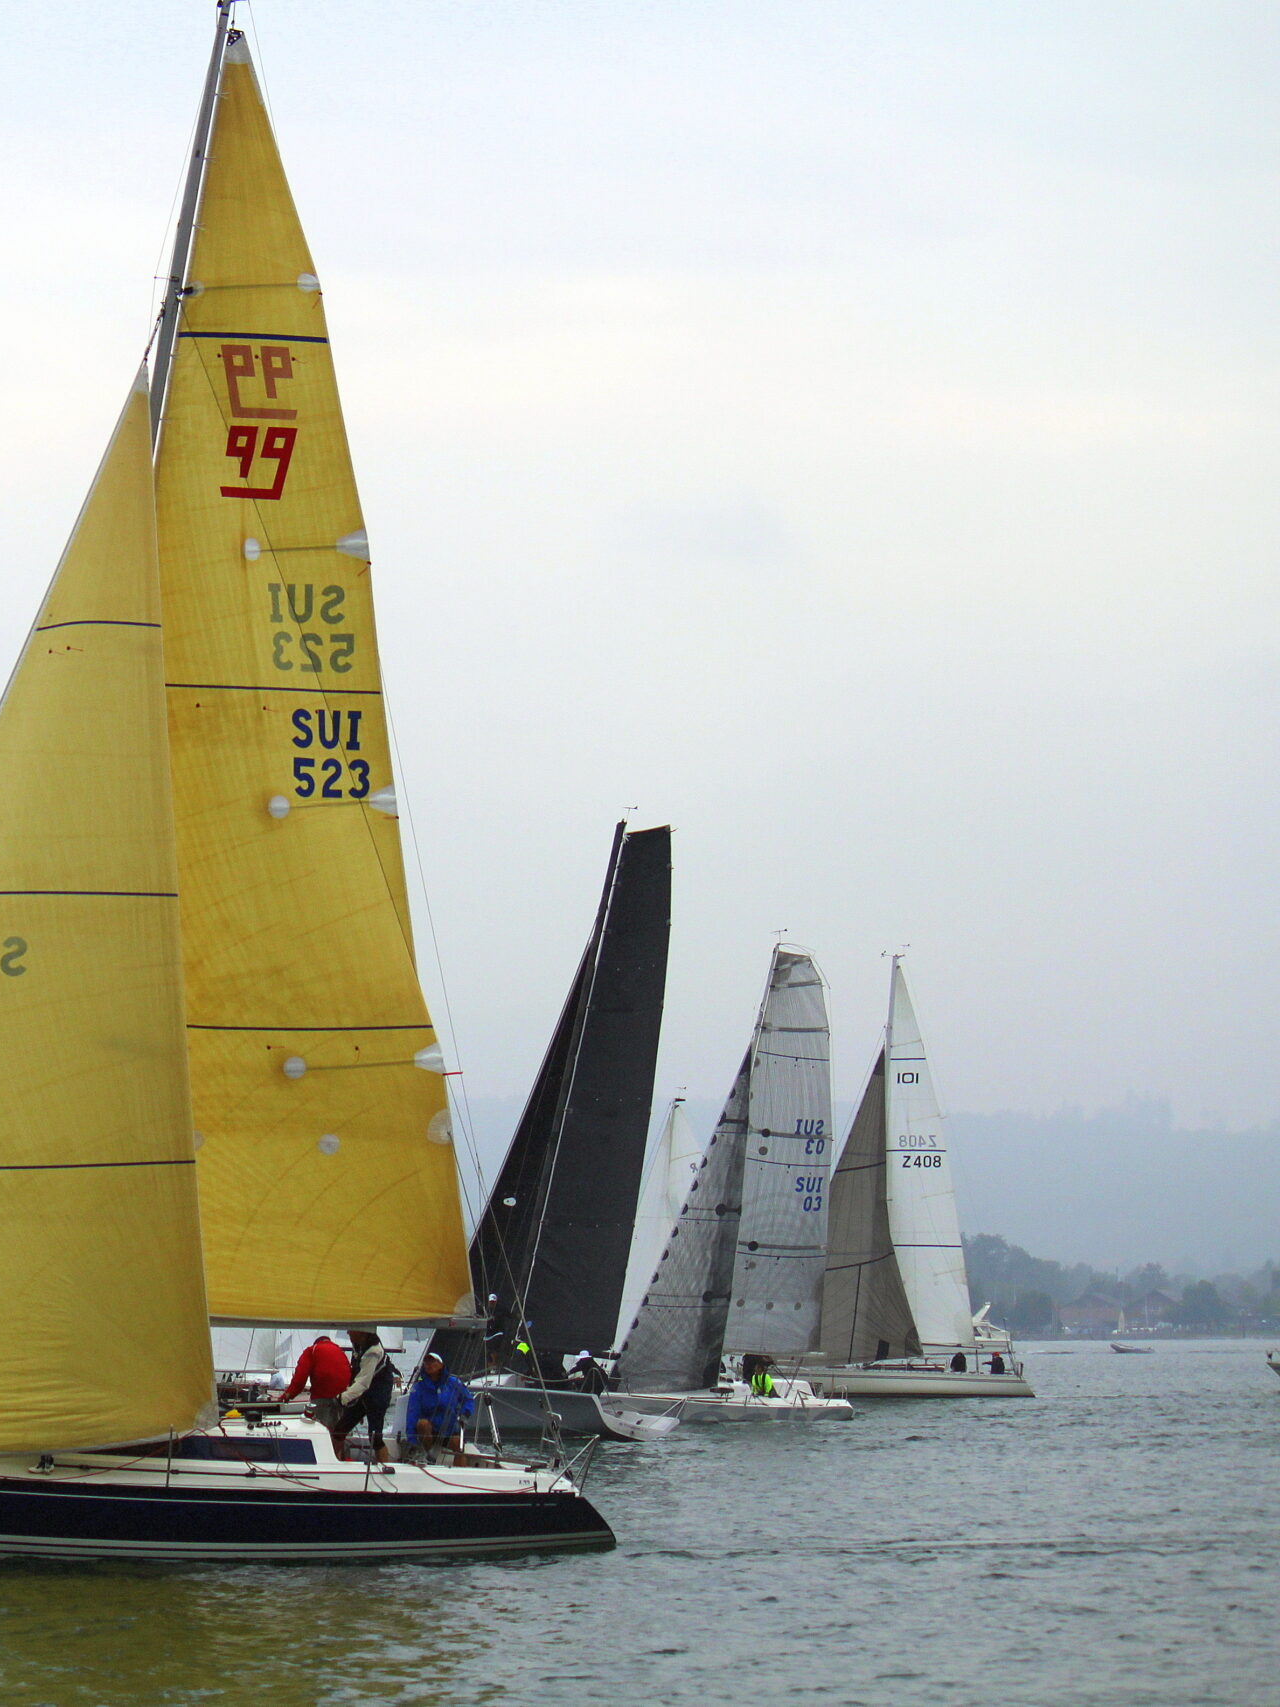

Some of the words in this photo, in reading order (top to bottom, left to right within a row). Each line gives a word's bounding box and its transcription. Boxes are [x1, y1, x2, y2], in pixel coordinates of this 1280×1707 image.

[220, 425, 298, 500] 99
[292, 708, 362, 750] SUI
[293, 757, 370, 799] 523
[902, 1155, 942, 1169] Z408
[795, 1176, 823, 1193] SUI
[803, 1196, 822, 1212] 03
